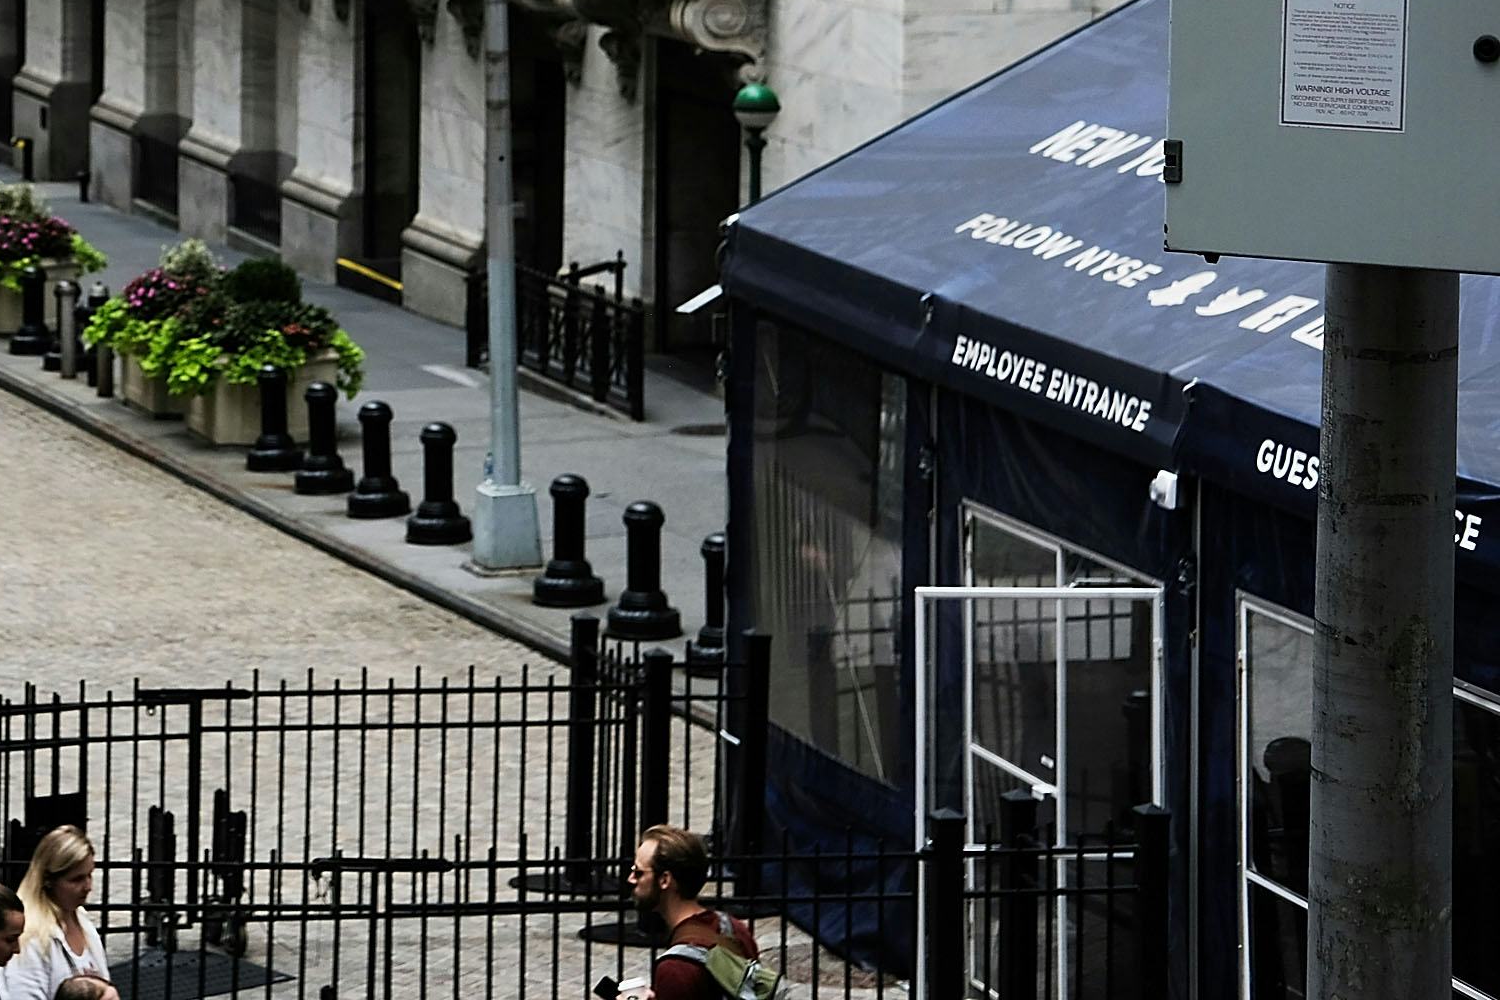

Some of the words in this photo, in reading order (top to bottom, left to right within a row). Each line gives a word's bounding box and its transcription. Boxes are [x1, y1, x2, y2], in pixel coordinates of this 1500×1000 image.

[1291, 94, 1322, 102] DISCONNECT
[1295, 84, 1334, 94] WARNING!
[1335, 87, 1354, 95] HIGH
[1356, 88, 1391, 97] VOLTAGE
[1028, 120, 1153, 169] NEW
[1116, 138, 1166, 183] YO
[955, 212, 1084, 260] FOLLOW
[1063, 246, 1164, 288] NYSE
[951, 334, 1048, 395] EMPLOYEE
[1045, 367, 1152, 433] ENTRANCE
[1256, 438, 1321, 490] GUES
